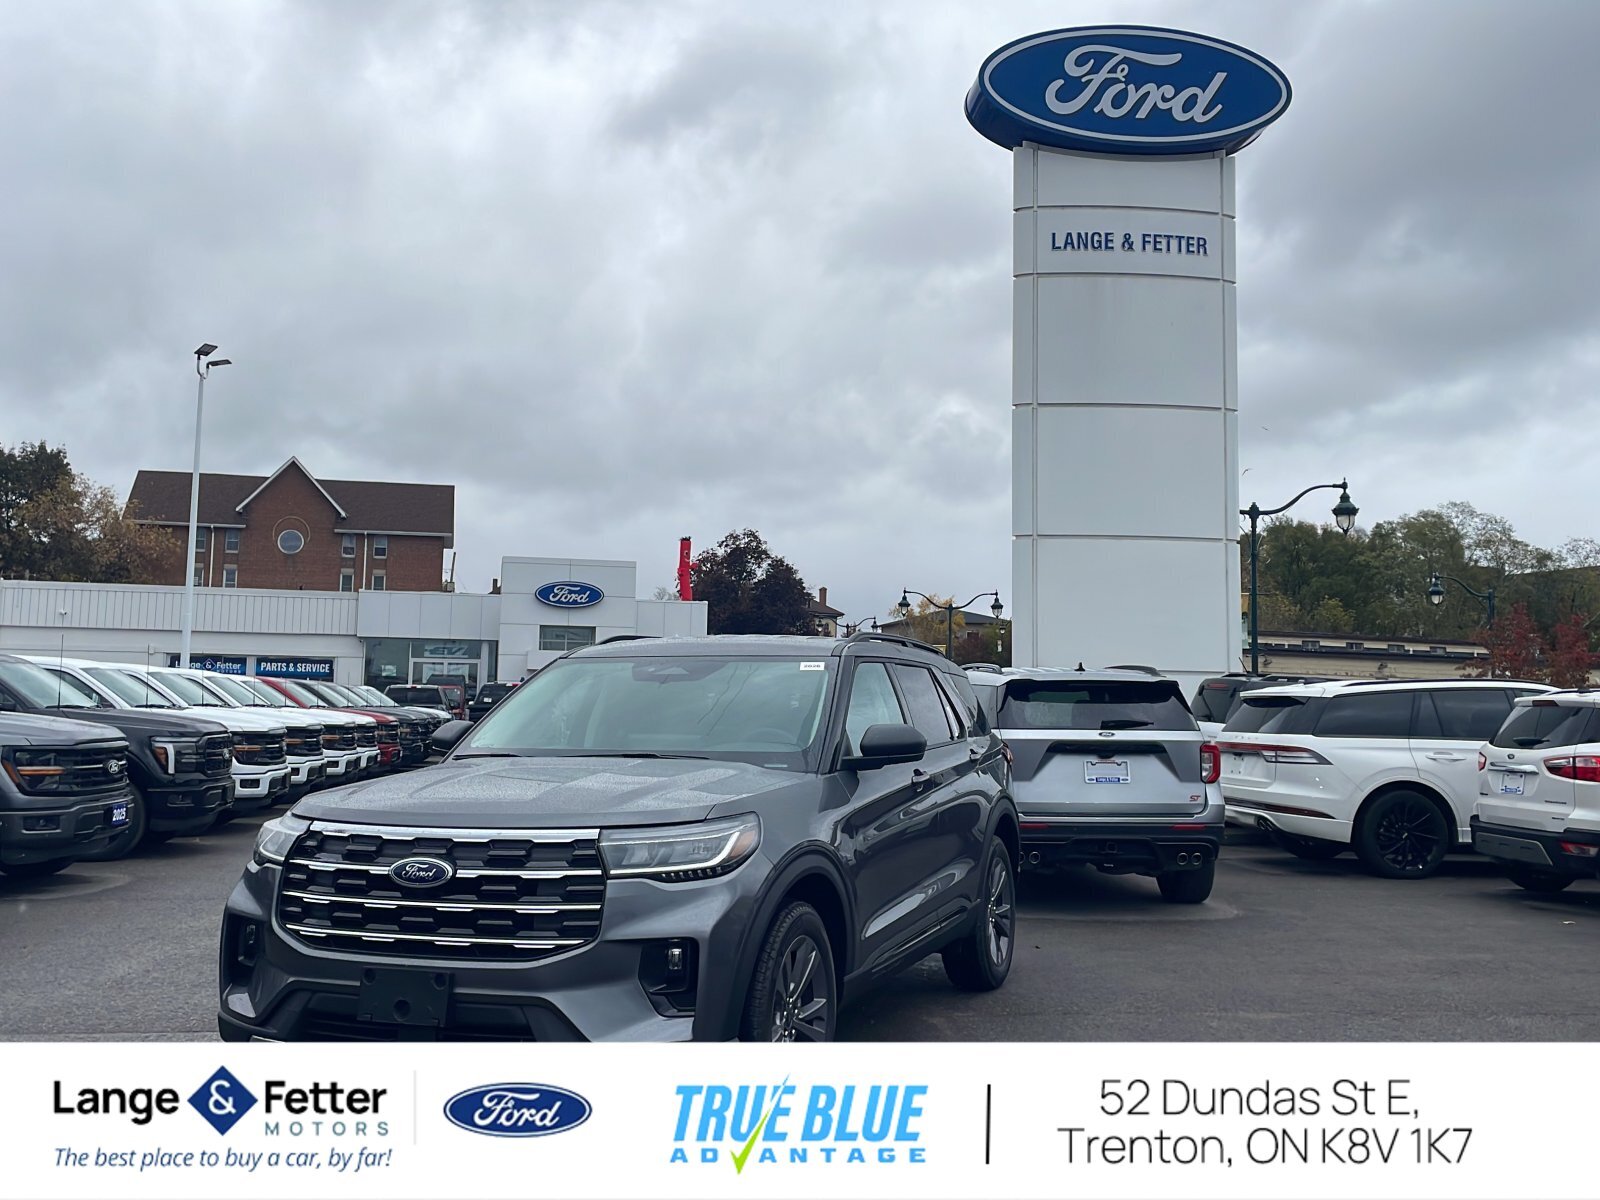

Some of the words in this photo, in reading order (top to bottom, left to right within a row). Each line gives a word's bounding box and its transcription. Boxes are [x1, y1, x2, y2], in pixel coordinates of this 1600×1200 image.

[1045, 44, 1228, 123] Ford
[1051, 231, 1115, 252] LANGE
[1121, 232, 1136, 252] &
[1141, 233, 1209, 257] FETTER
[549, 585, 591, 603] Ford
[175, 660, 201, 670] Lge
[216, 661, 242, 670] Fetter
[260, 662, 287, 672] PARTS
[288, 662, 295, 672] &
[296, 663, 330, 673] SERVICE
[112, 807, 127, 821] 2025
[402, 863, 437, 880] Ford
